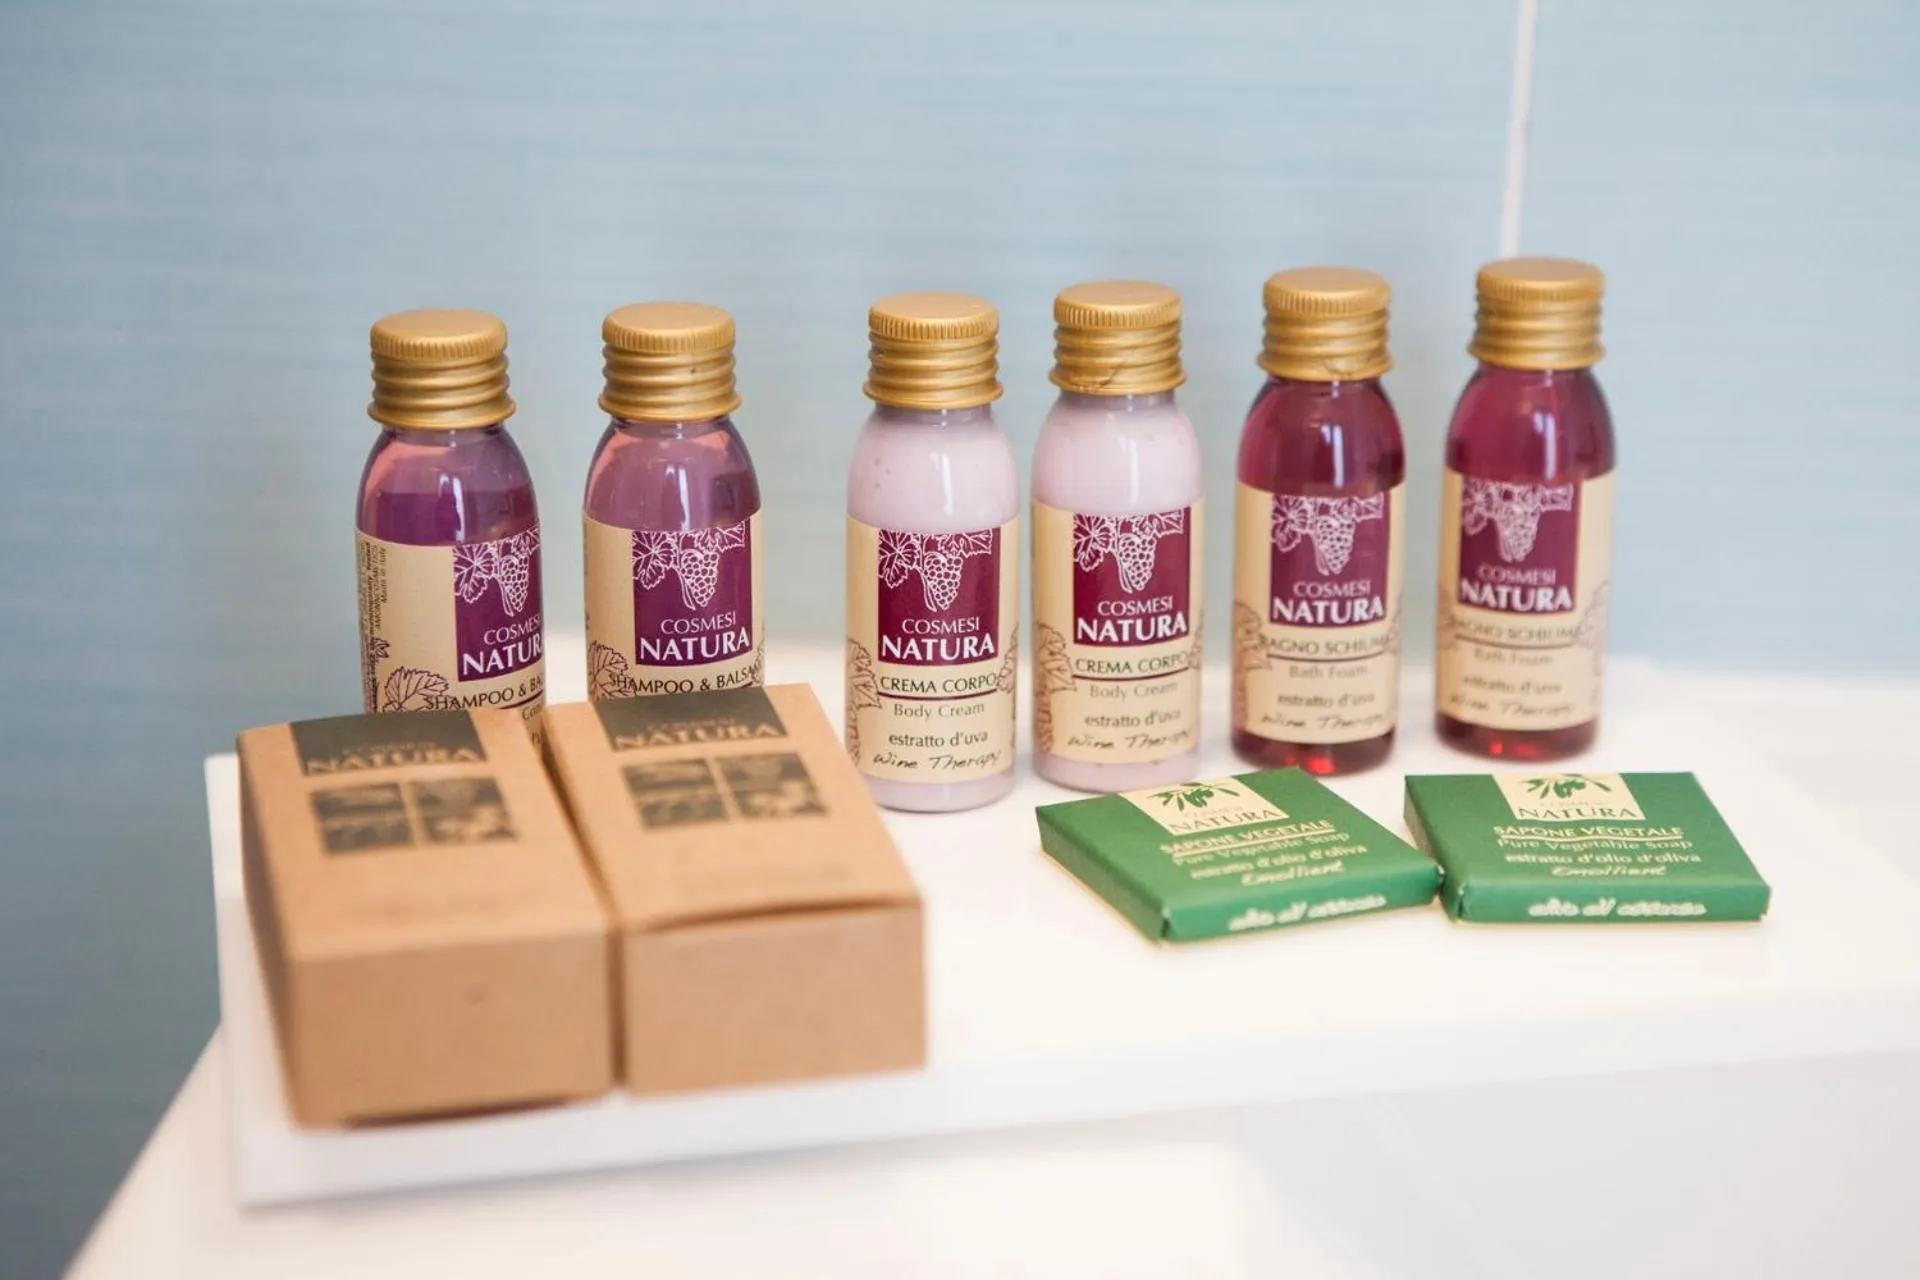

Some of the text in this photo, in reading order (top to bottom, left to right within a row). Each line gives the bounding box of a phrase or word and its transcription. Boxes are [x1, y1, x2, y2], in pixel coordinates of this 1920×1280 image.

[1478, 563, 1556, 585] COSMESI
[1293, 580, 1371, 598] COSMESI
[1460, 577, 1573, 611] NATURA
[1097, 596, 1173, 616] COSMESI
[1273, 596, 1384, 624] NATURA
[484, 614, 541, 645] COSMES
[661, 612, 736, 635] COSMESI
[902, 617, 980, 634] COSMESI
[1077, 611, 1188, 642] NATURA
[462, 633, 541, 675] NATUR
[640, 627, 750, 661] NATURA
[882, 633, 995, 660] NATURA
[1075, 651, 1190, 674] CREMA CORPO
[608, 664, 762, 693] SHAMPOO & BALSAM
[880, 673, 997, 693] CREMA CORPO
[424, 687, 513, 709] SHAMPOO
[518, 682, 526, 696] &
[1090, 682, 1177, 702] Body Cream
[894, 703, 985, 722] Body Cream
[1084, 709, 1181, 728] estratto d'uva
[615, 724, 780, 749] NATURA
[889, 730, 988, 748] estratto d'uva
[1067, 733, 1115, 749] Wine
[873, 750, 1001, 770] Wine Therapy
[1169, 809, 1281, 831] NATURA
[1518, 807, 1637, 819] NATURA
[1160, 819, 1335, 854] SAPONE VEGETALE
[1306, 832, 1350, 846] Soap
[1493, 825, 1684, 838] SAPONE VEGETALE
[1497, 839, 1693, 853] Pure Vegetable Soap
[1504, 852, 1702, 864] estratto d'olio d'oliva
